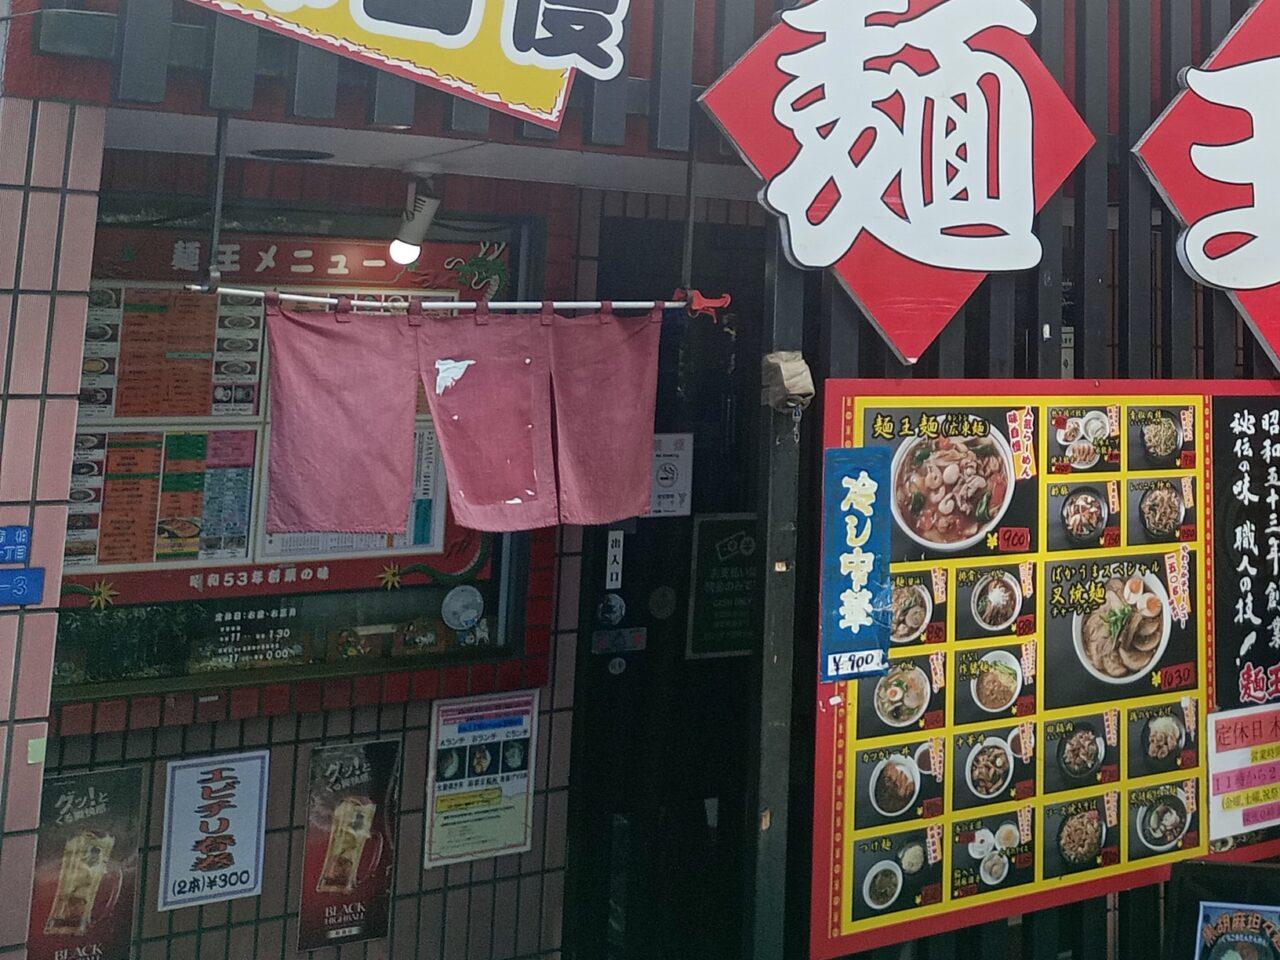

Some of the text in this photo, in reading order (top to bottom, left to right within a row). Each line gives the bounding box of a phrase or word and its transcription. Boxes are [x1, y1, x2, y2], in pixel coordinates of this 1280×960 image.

[1229, 410, 1261, 506] 秘伝の味
[609, 537, 621, 583] 出入口
[840, 469, 879, 634] 冷し中華
[1051, 561, 1161, 583] ばかうまスペシャル
[1215, 717, 1264, 747] 定休日
[324, 901, 367, 918] BLACK
